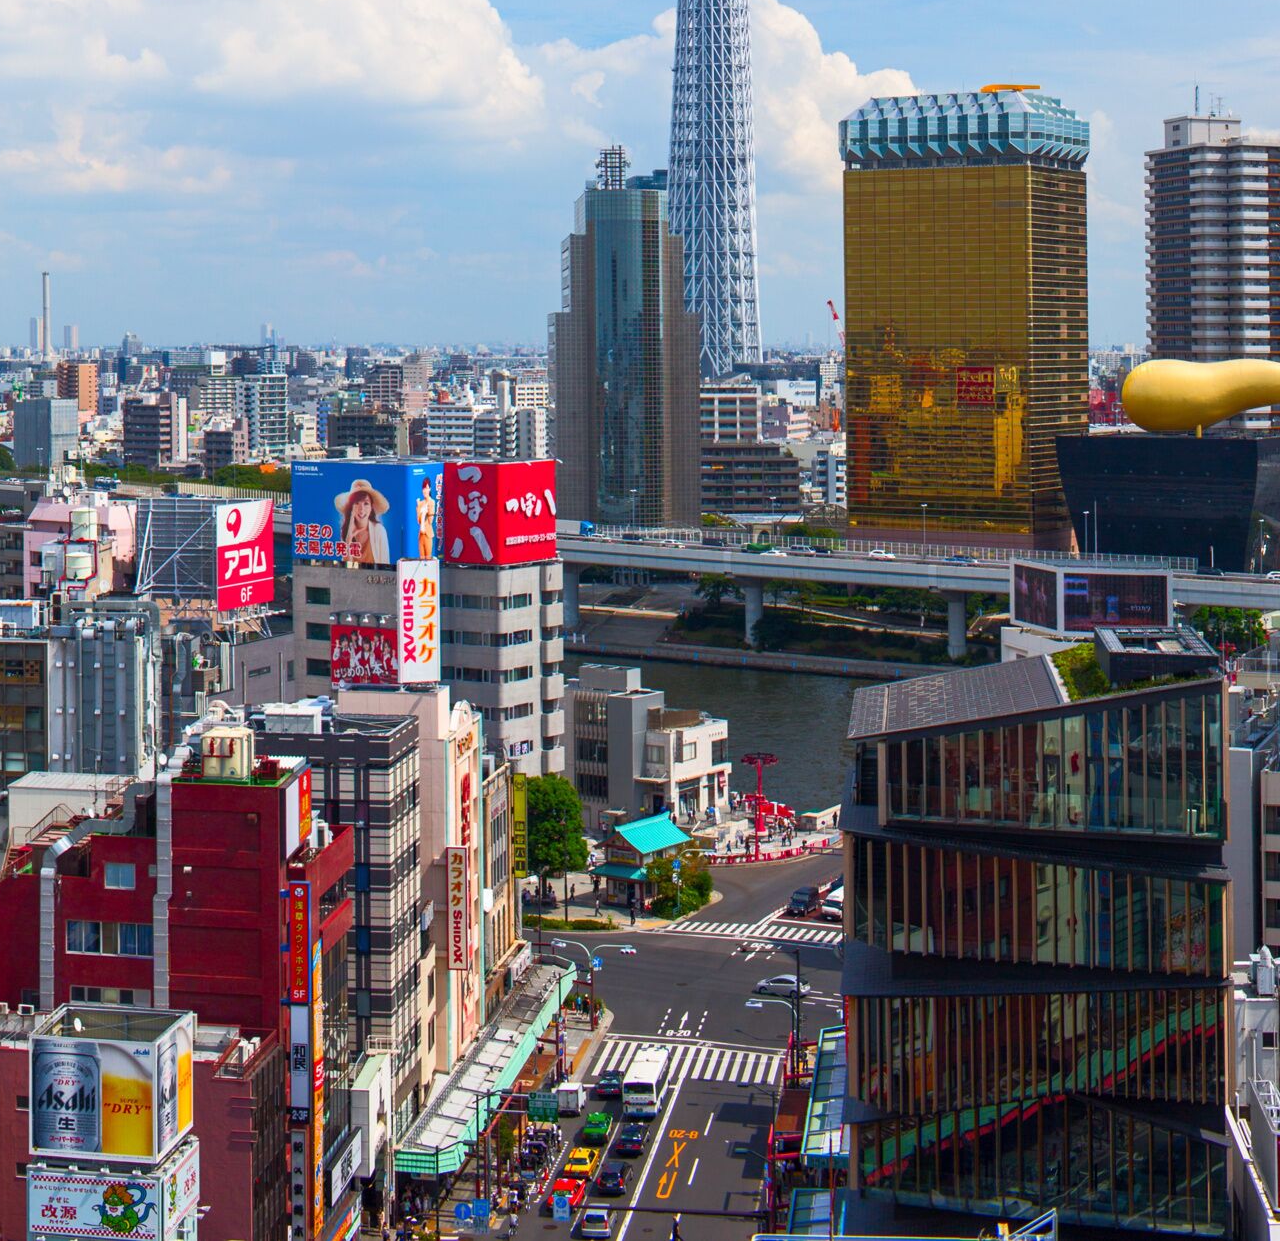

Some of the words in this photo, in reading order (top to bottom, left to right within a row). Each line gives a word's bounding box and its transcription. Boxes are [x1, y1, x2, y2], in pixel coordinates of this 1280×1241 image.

[450, 466, 493, 562] つぼ八
[505, 489, 556, 518] つぼ八
[294, 523, 332, 539] 東芝の
[294, 540, 362, 557] 太陽光発電
[224, 546, 267, 580] アコム
[240, 585, 253, 603] 6F
[403, 578, 417, 664] SHIDAX
[418, 577, 436, 663] カラオケ
[450, 852, 463, 907] カラオケ
[294, 901, 304, 986] 浅草タウンホテル
[452, 910, 463, 964] SHIDAX
[293, 989, 306, 999] 5F
[133, 1048, 150, 1056] Asahi
[293, 1045, 306, 1070] 和民
[38, 1083, 96, 1113] Asahi
[58, 1116, 75, 1131] 生
[49, 1135, 85, 1143] スーパードライ
[41, 1204, 77, 1220] 改源
[48, 1196, 70, 1204] かぜに
